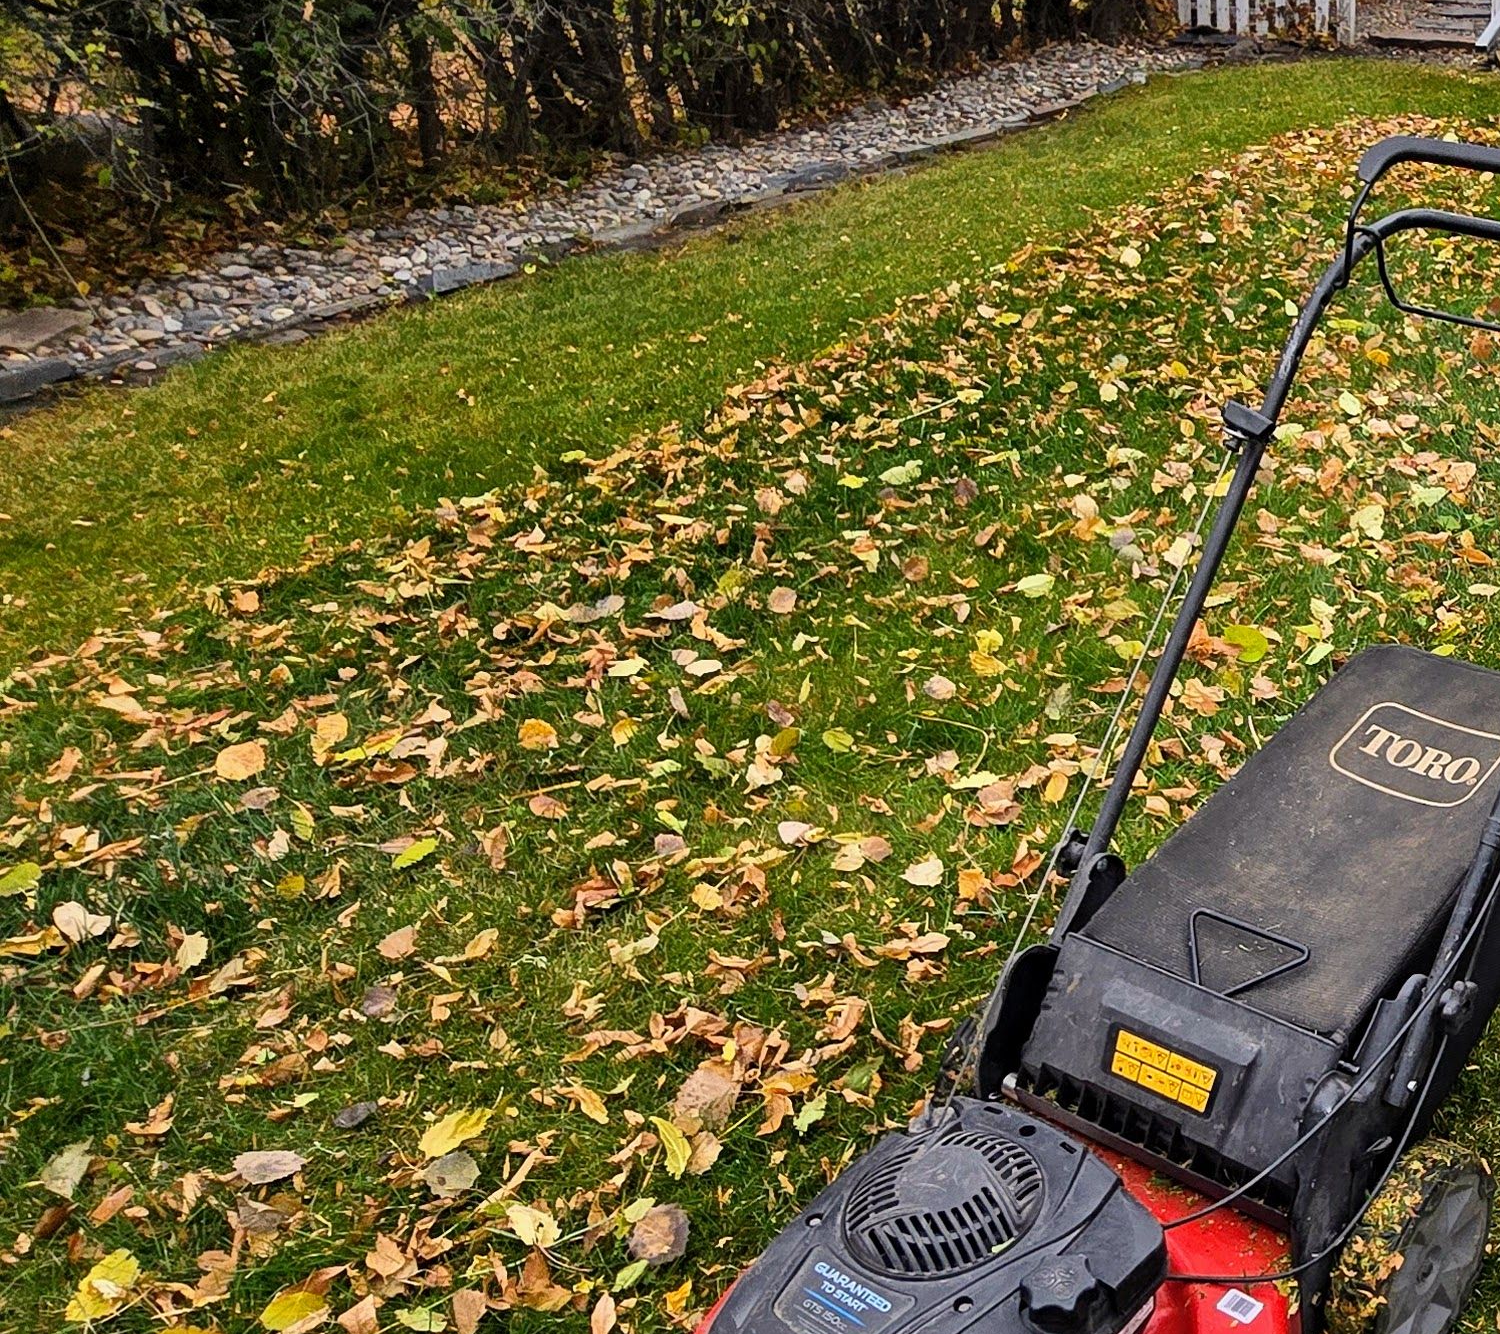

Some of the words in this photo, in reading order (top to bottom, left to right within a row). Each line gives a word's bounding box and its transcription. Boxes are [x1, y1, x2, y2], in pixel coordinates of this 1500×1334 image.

[1358, 724, 1480, 784] TORO
[802, 1299, 825, 1315] GTS
[814, 1261, 892, 1313] GUARANTEED
[820, 1280, 836, 1294] TO
[832, 1289, 869, 1312] START
